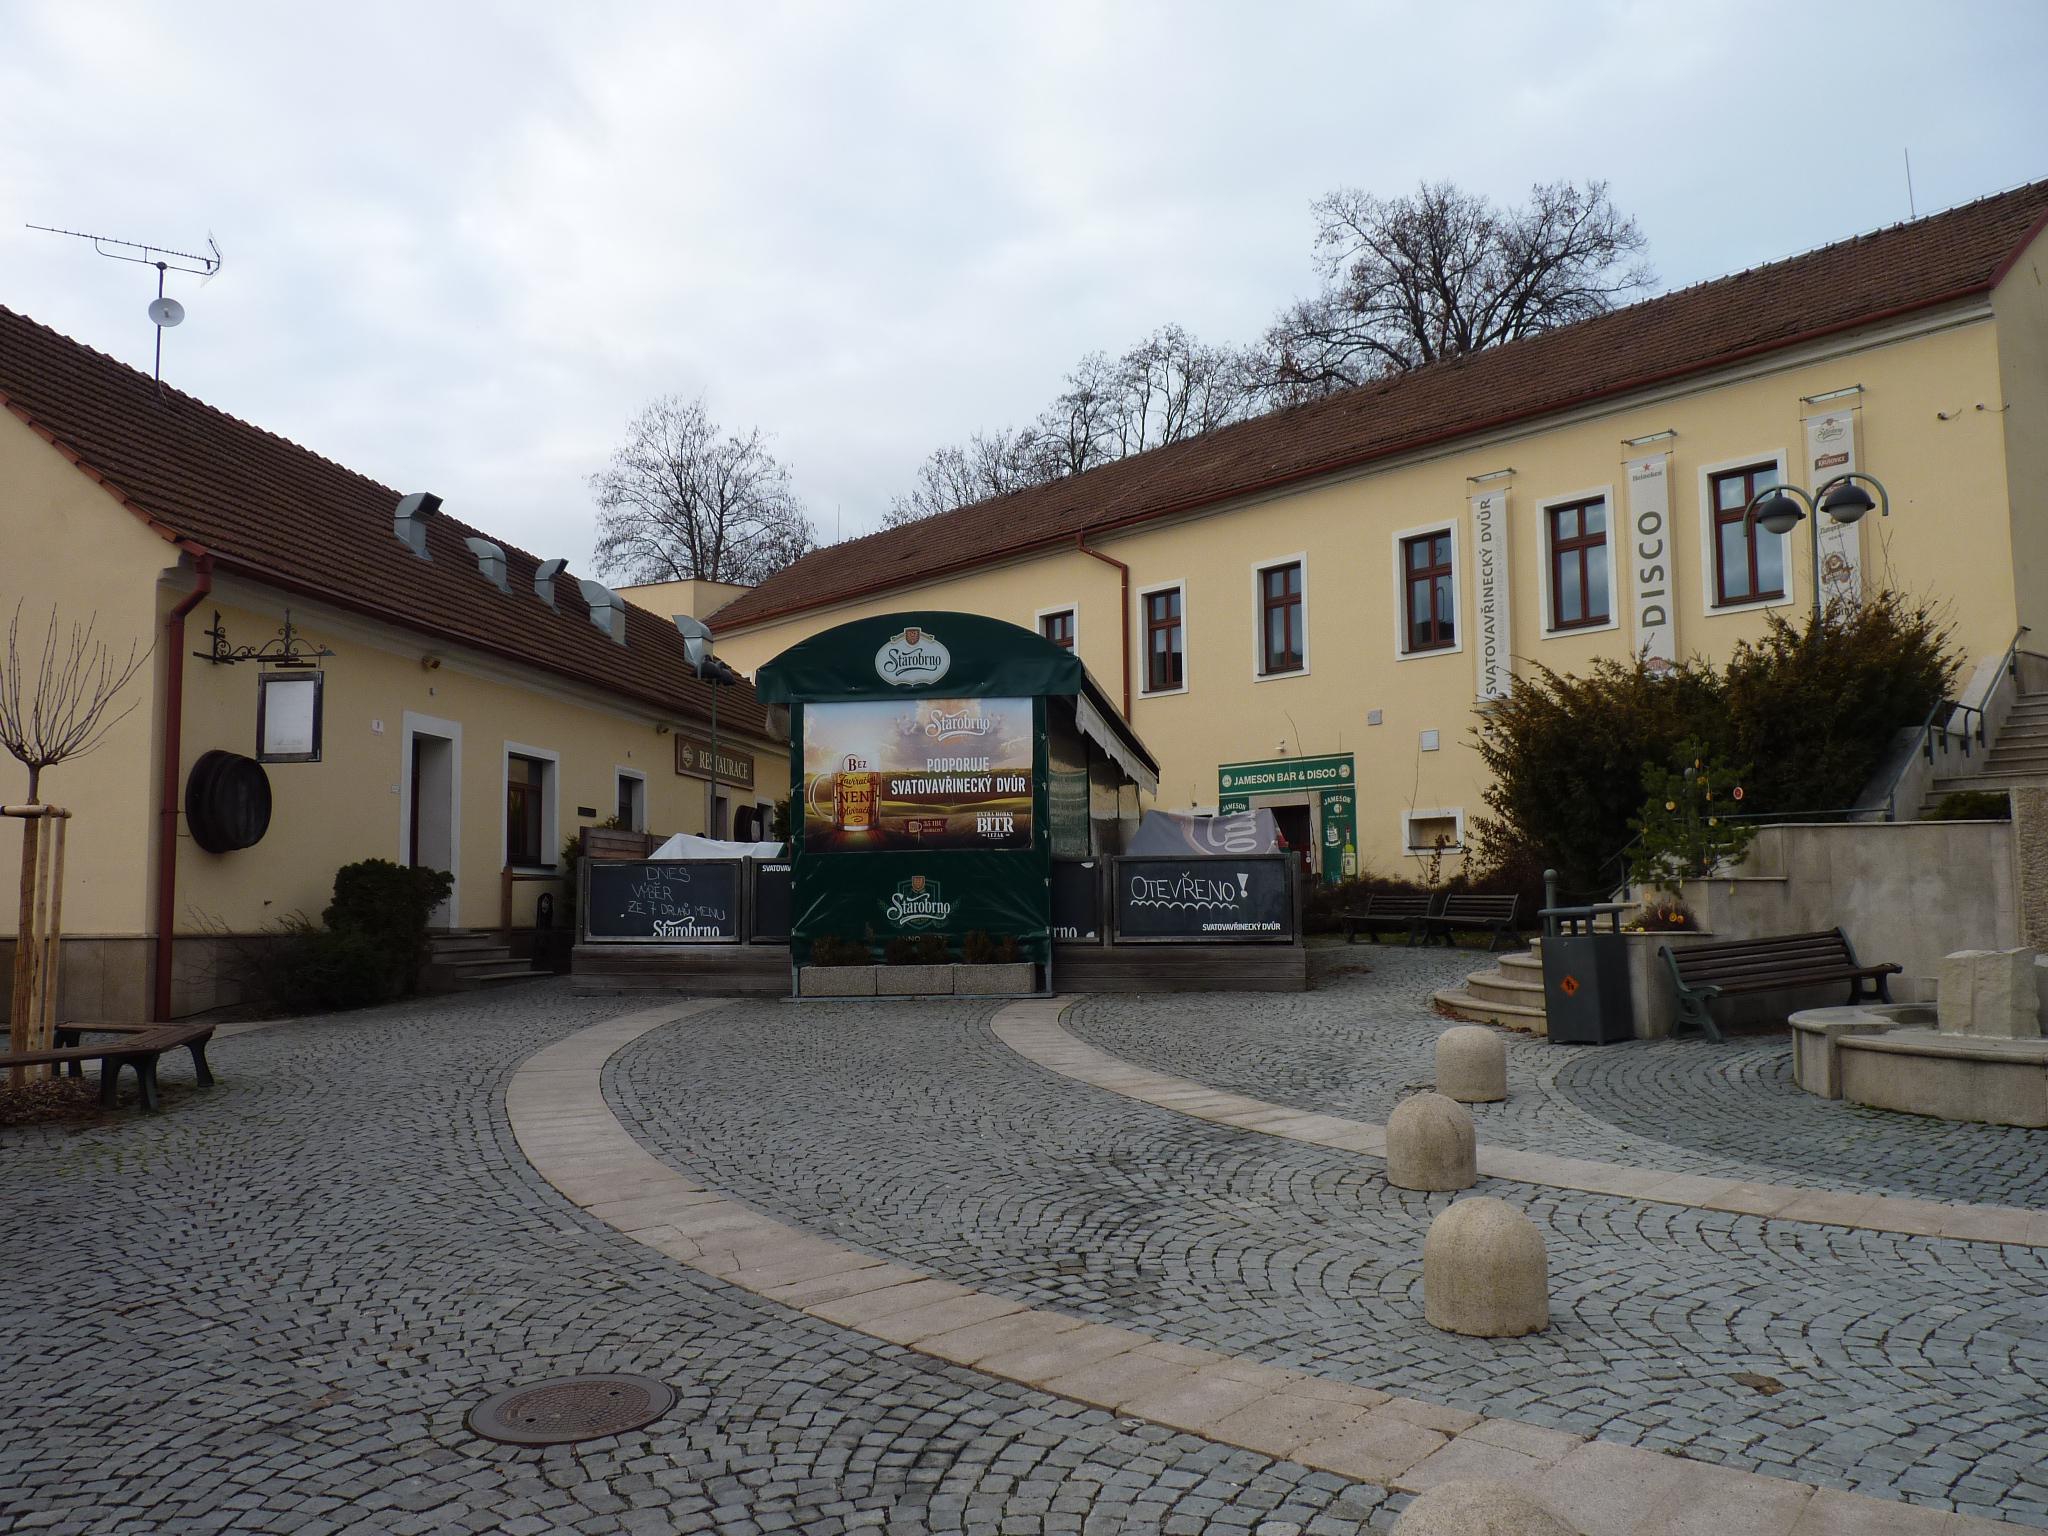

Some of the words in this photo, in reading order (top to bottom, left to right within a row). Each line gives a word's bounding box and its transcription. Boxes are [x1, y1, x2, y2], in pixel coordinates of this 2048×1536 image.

[1477, 498, 1491, 543] DVŮR
[1637, 511, 1666, 628] DISCO
[1478, 548, 1497, 695] SVATOVAVŘINECKÝ
[884, 648, 941, 676] Starobrno
[925, 710, 990, 741] Starobrno
[698, 750, 749, 780] RESTAURACE
[928, 757, 990, 773] PODPORUJE
[891, 774, 992, 795] SVATOVAVŘINECKÝ
[996, 774, 1026, 793] DVŮR
[1234, 773, 1275, 786] JAMESON
[1277, 772, 1297, 782] BAR
[1298, 771, 1306, 780] &
[1307, 768, 1337, 779] DISCO
[1221, 802, 1247, 812] JAMESON
[1323, 795, 1350, 806] JAMESON
[976, 817, 1014, 833] BITR
[646, 866, 690, 883] DNES
[628, 901, 647, 915] ZE
[694, 905, 725, 920] MENU
[886, 893, 951, 925] Starobrno
[1202, 921, 1261, 931] SVATOVAVŘINECKÝ
[1262, 921, 1281, 931] DVŮR
